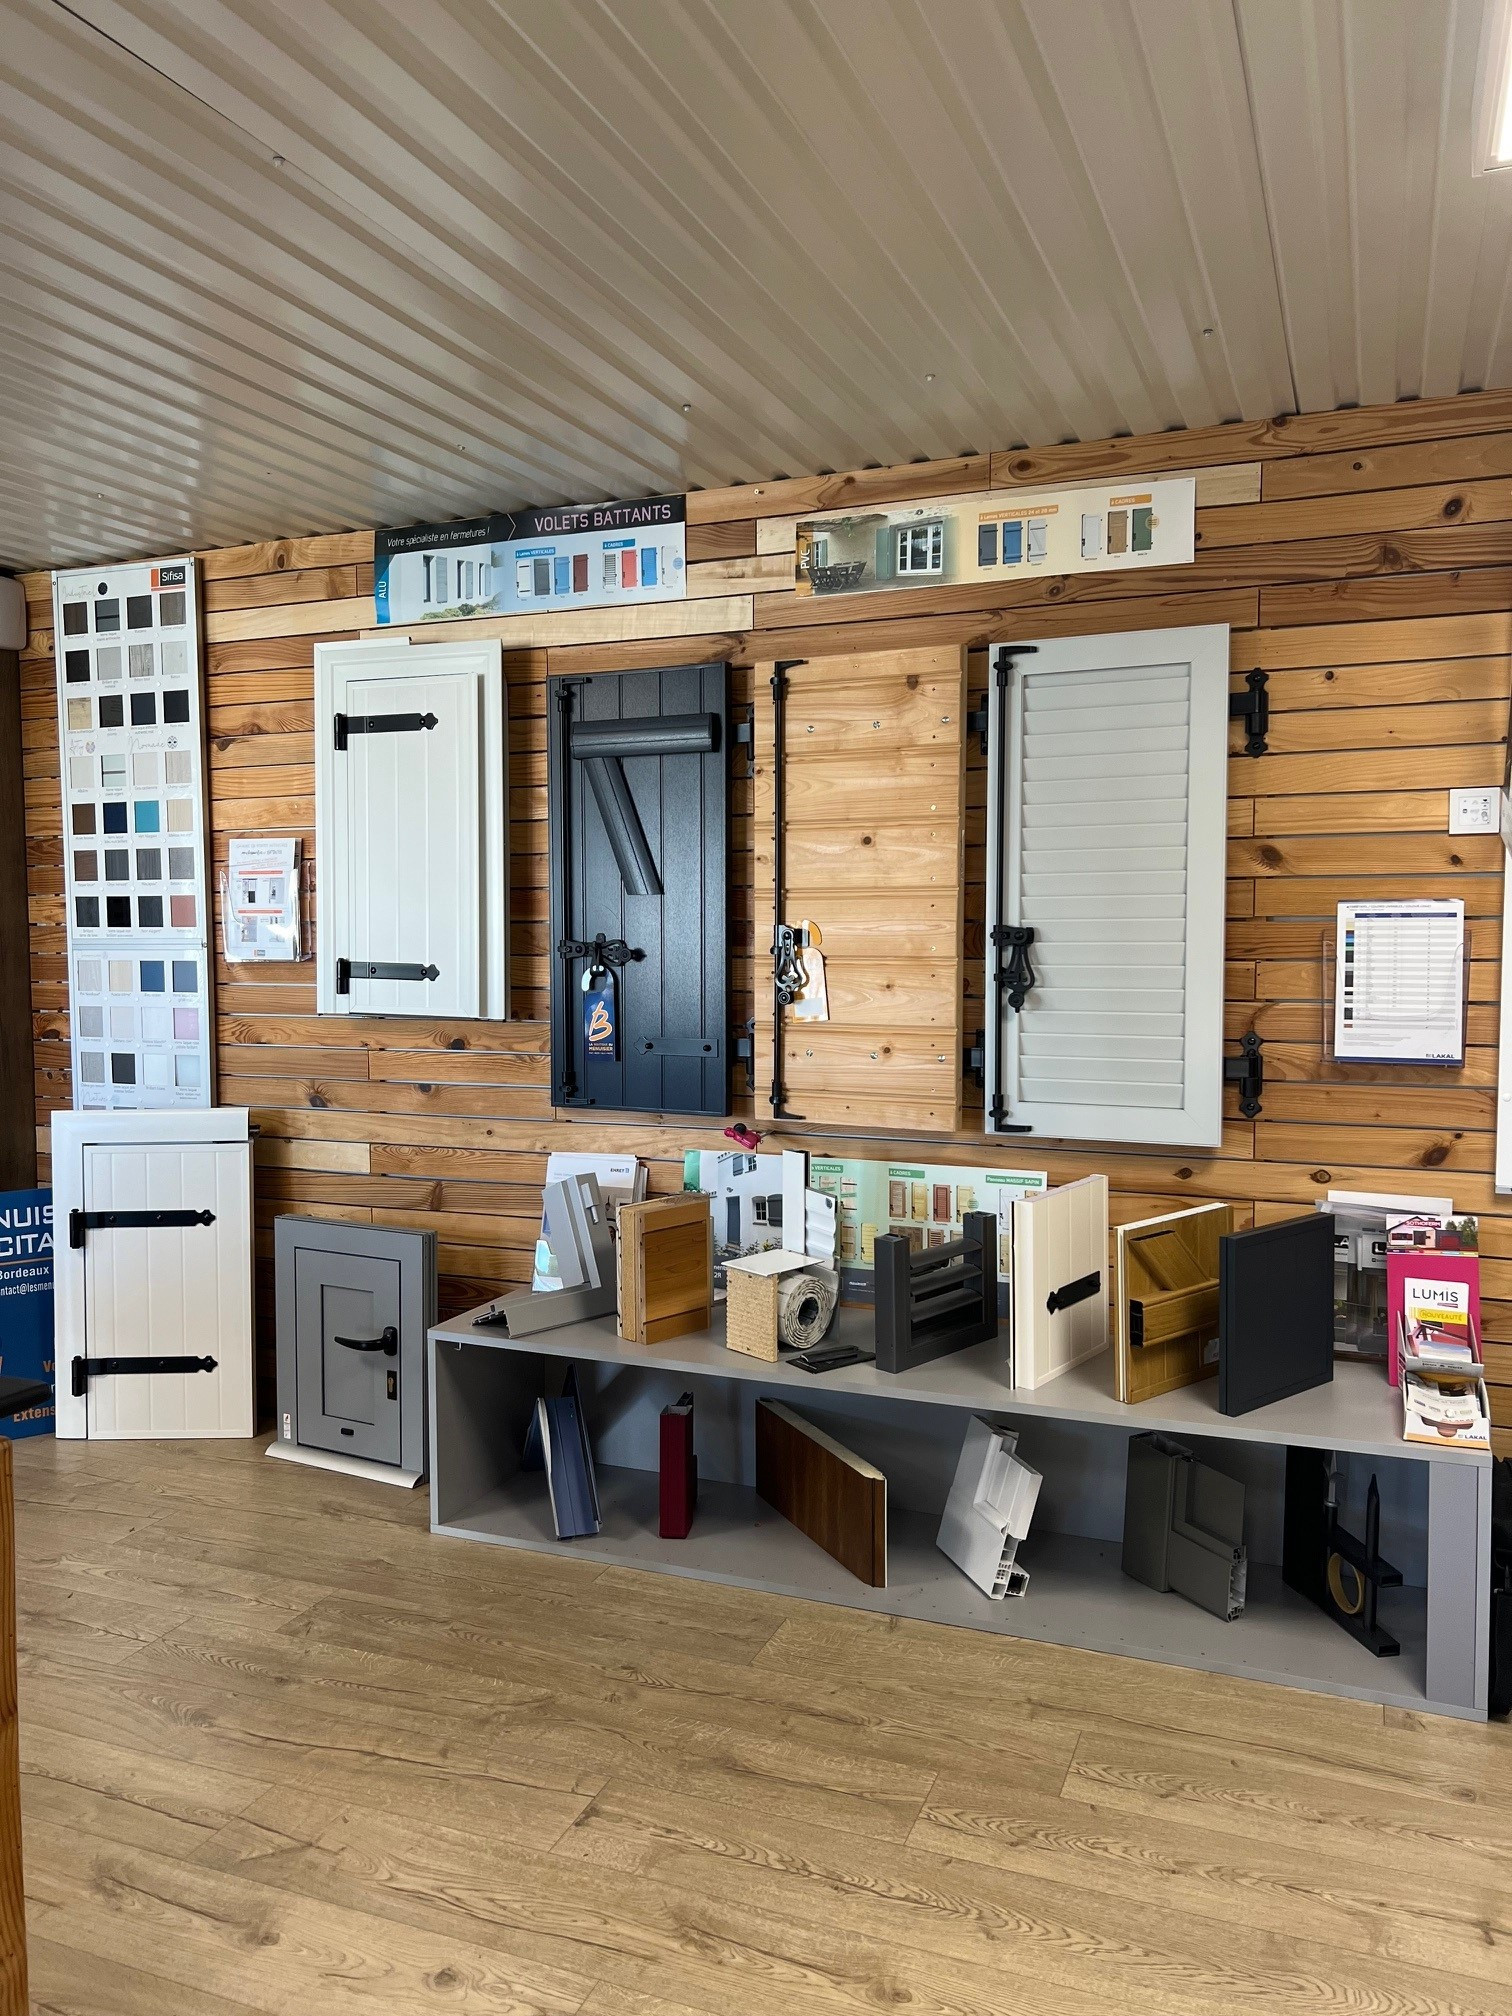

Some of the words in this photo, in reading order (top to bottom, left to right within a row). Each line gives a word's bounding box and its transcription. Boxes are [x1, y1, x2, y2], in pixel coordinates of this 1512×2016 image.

[534, 512, 589, 532] VOLETS
[594, 504, 671, 526] BATTANTS
[998, 510, 1027, 518] VERTICALES
[387, 538, 405, 547] Votre
[406, 532, 438, 546] spécialiste
[440, 532, 449, 541] en
[450, 527, 486, 540] fermetures
[531, 548, 554, 556] VERTICALES
[801, 549, 809, 569] PVC
[162, 571, 184, 582] Sifisa
[379, 581, 387, 599] ALU
[589, 1001, 613, 1042] B
